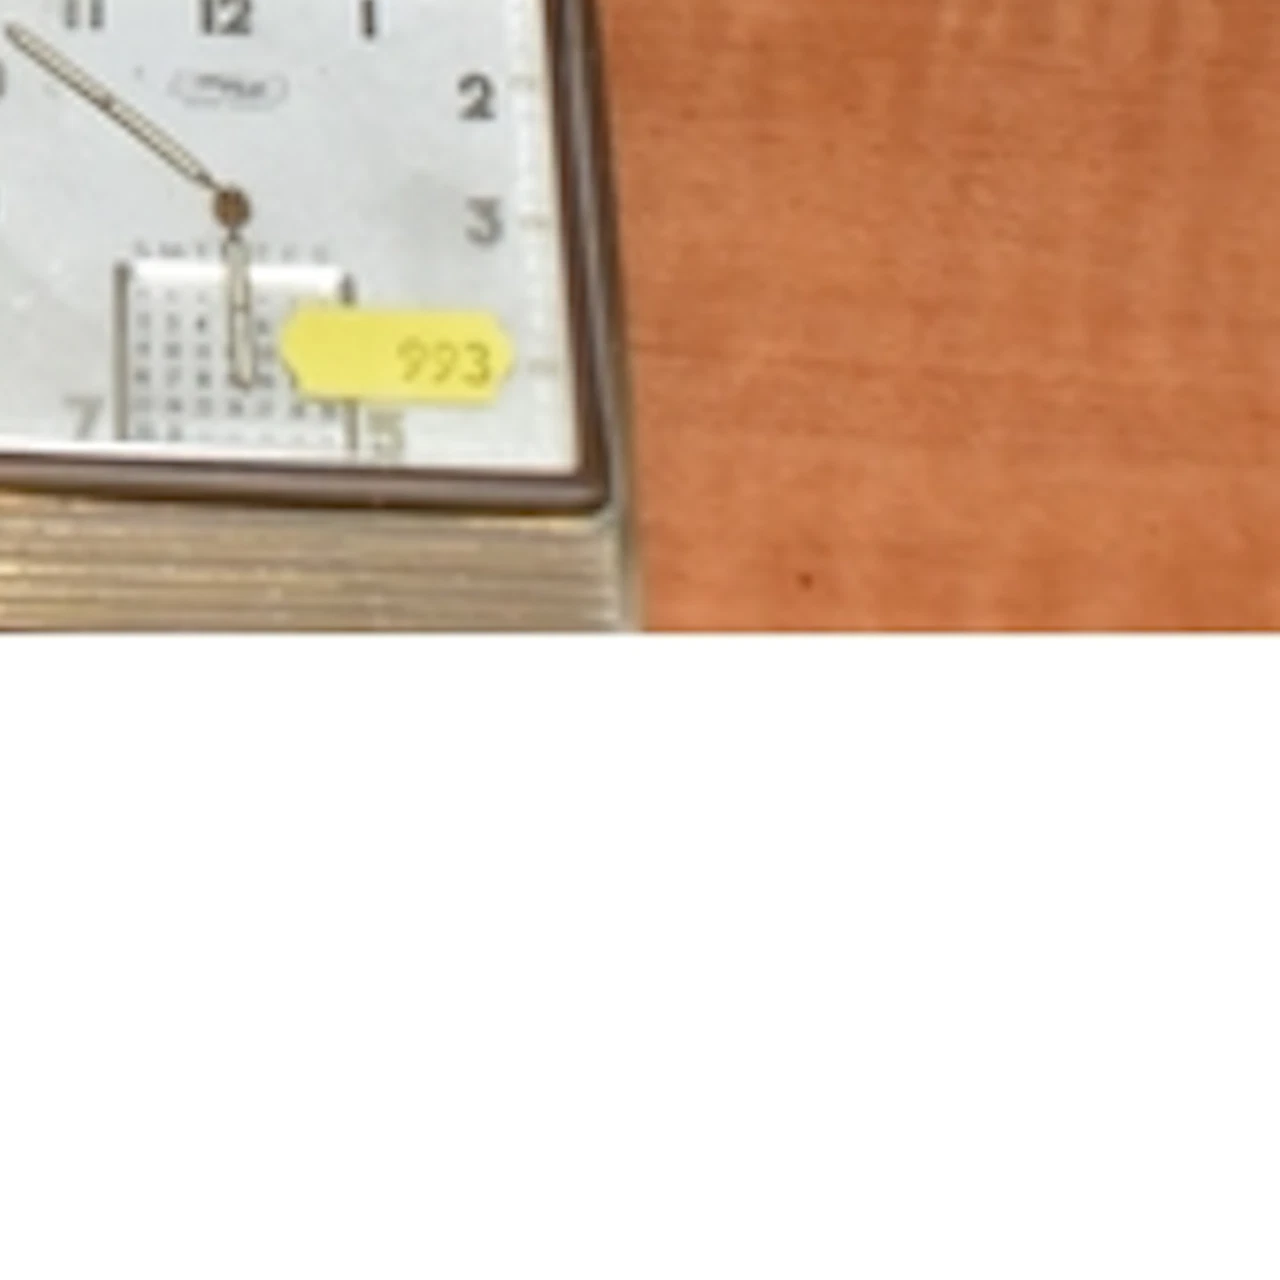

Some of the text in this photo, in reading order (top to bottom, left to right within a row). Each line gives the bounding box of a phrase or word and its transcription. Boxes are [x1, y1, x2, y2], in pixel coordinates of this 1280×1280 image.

[457, 72, 497, 121] 2
[465, 196, 504, 247] 3
[397, 335, 493, 387] 993
[63, 395, 104, 441] 7
